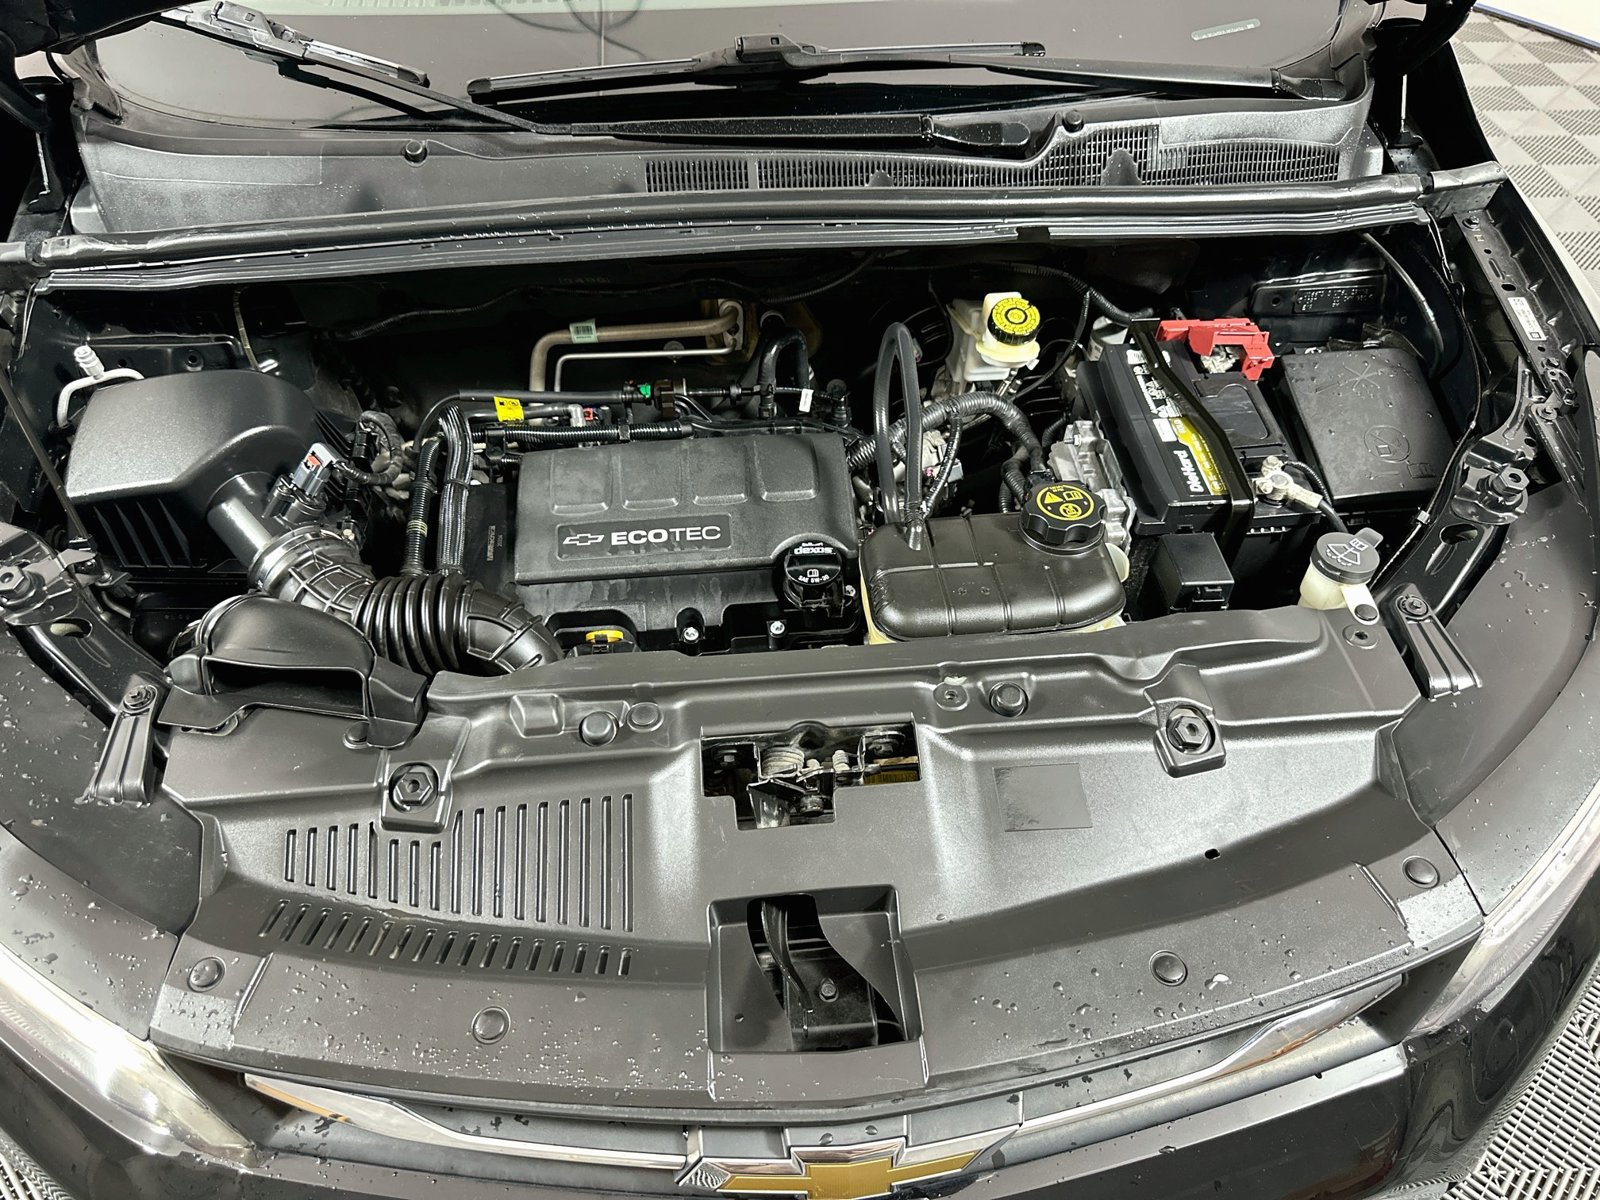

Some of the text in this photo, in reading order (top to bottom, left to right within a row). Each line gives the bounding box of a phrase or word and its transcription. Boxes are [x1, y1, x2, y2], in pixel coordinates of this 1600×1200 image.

[1173, 450, 1204, 493] DieHard
[611, 525, 721, 546] ECOTEC
[794, 546, 833, 555] dexos
